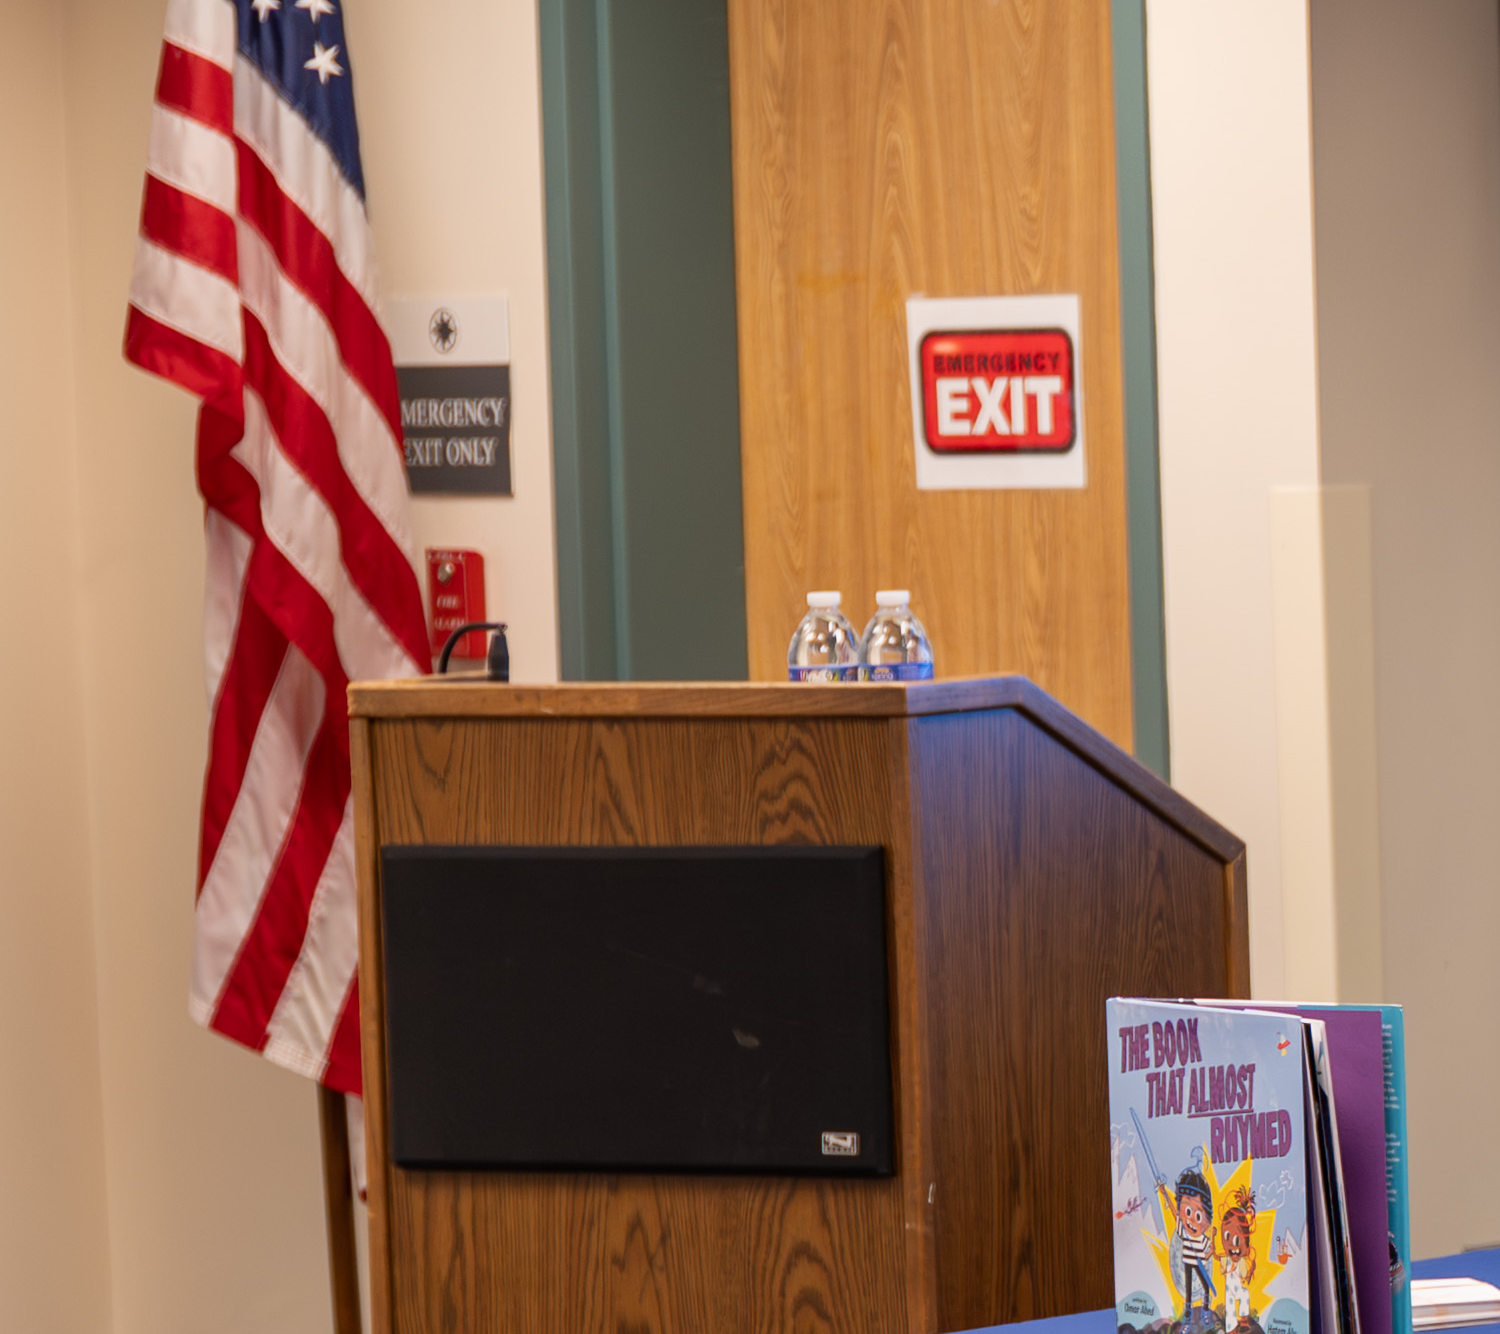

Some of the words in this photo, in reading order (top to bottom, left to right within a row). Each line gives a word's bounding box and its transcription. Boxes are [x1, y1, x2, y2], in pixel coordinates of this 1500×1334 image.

[933, 352, 1061, 373] EMERGENCY
[401, 397, 507, 427] MERGENCY
[936, 375, 1062, 436] EXIT
[446, 436, 499, 467] ONLY
[1119, 1024, 1149, 1073] THE
[1152, 1017, 1202, 1069] BOOK
[1146, 1068, 1185, 1118] THAT
[1188, 1064, 1256, 1114] ALMOST
[1210, 1109, 1292, 1164] RHYMED
